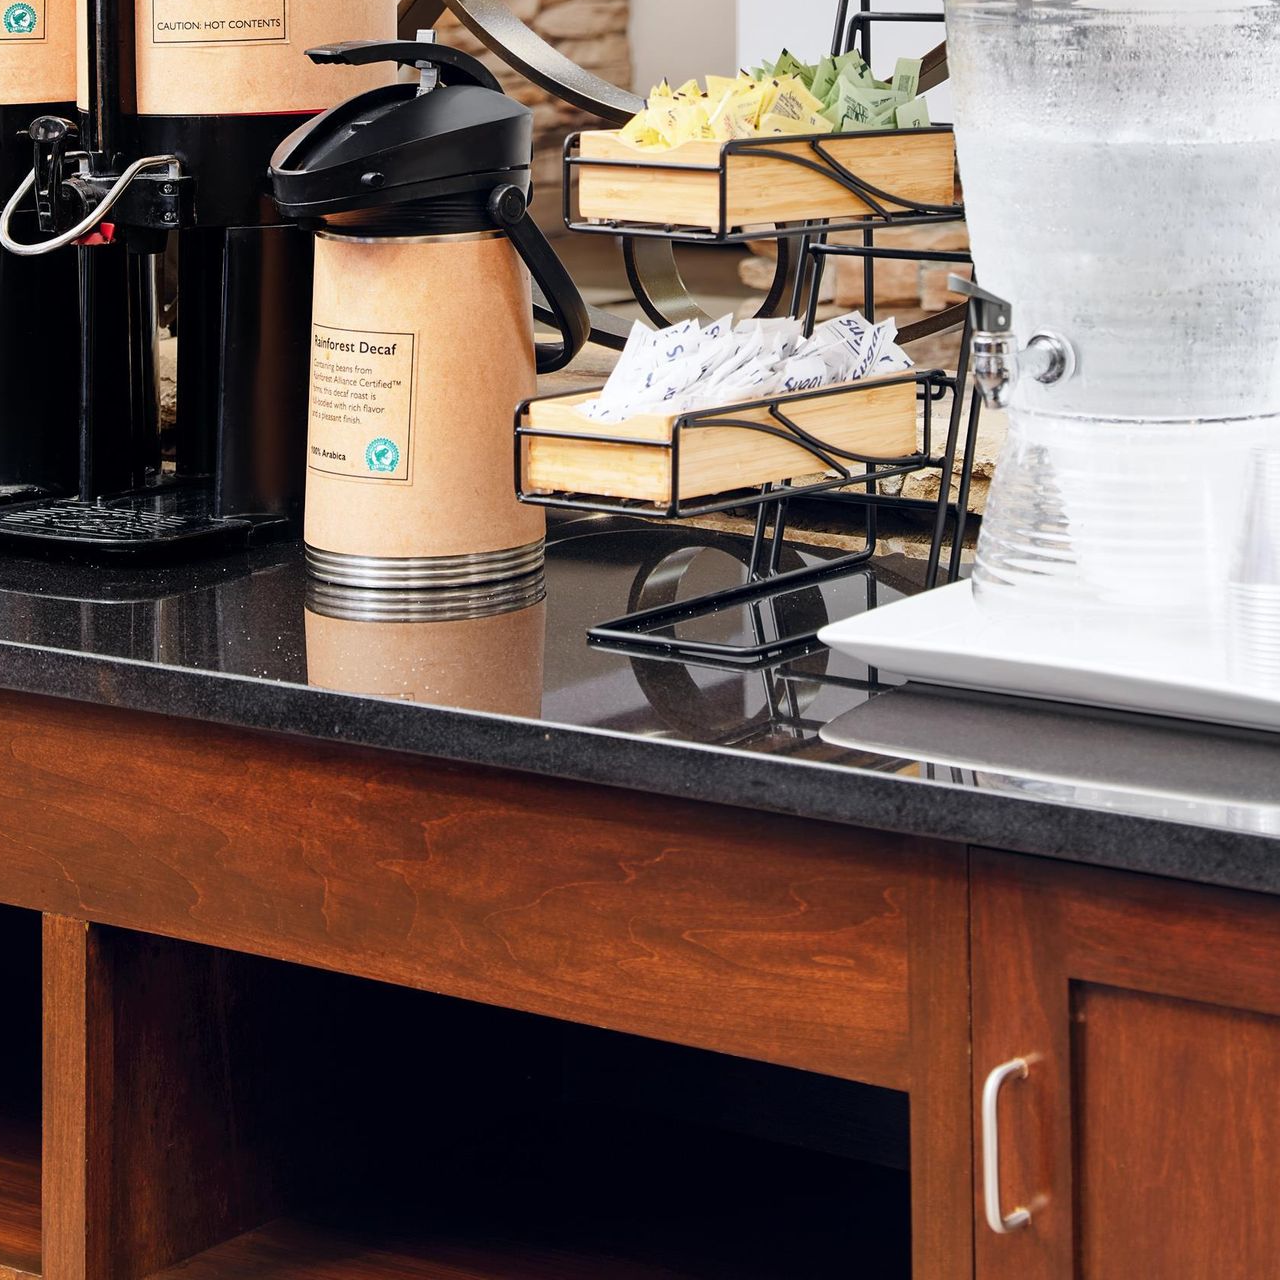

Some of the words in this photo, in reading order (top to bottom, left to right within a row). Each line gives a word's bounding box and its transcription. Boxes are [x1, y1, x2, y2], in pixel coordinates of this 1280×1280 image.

[157, 21, 202, 31] CAUTION:
[204, 20, 225, 30] HOT
[228, 18, 281, 29] CONTENTS
[314, 334, 355, 353] Rainforest
[359, 341, 398, 356] Decaf
[336, 363, 353, 373] beans
[354, 365, 373, 375] from
[334, 375, 358, 387] Alliance
[333, 388, 349, 397] decaf
[350, 391, 368, 401] roast
[370, 392, 377, 401] is
[333, 400, 347, 411] with
[348, 402, 362, 412] rich
[363, 404, 385, 414] flavor
[343, 414, 362, 425] finish.
[322, 450, 346, 461] Arabica
